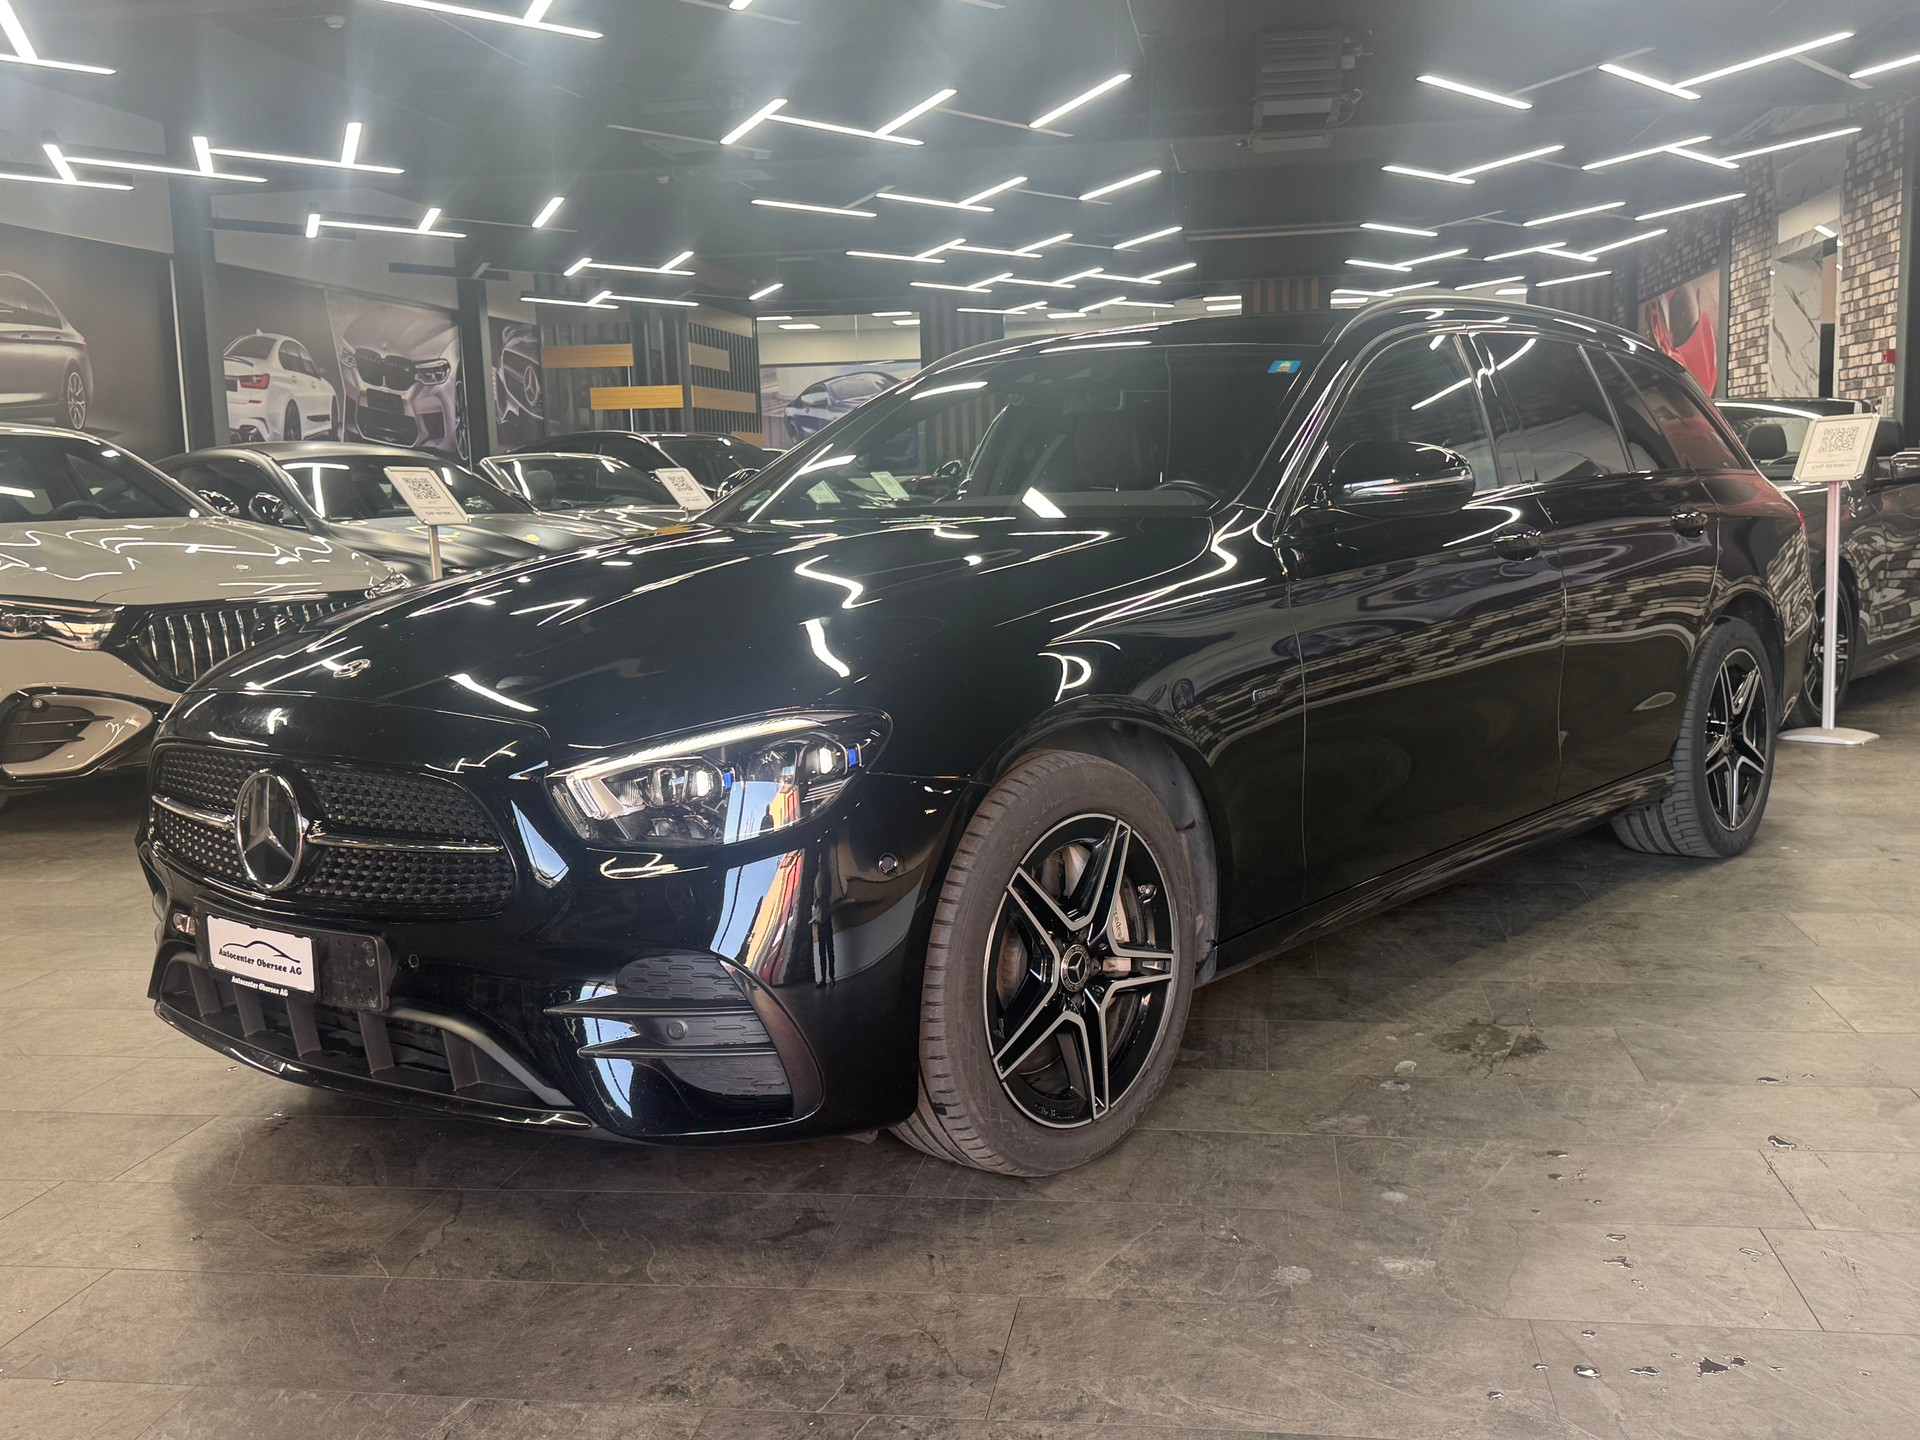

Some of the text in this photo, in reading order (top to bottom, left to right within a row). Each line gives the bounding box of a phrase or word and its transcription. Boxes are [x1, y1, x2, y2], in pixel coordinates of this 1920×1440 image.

[219, 947, 302, 976] Autocenter Obersee AG
[231, 975, 289, 997] Autocenter Obersee AG
